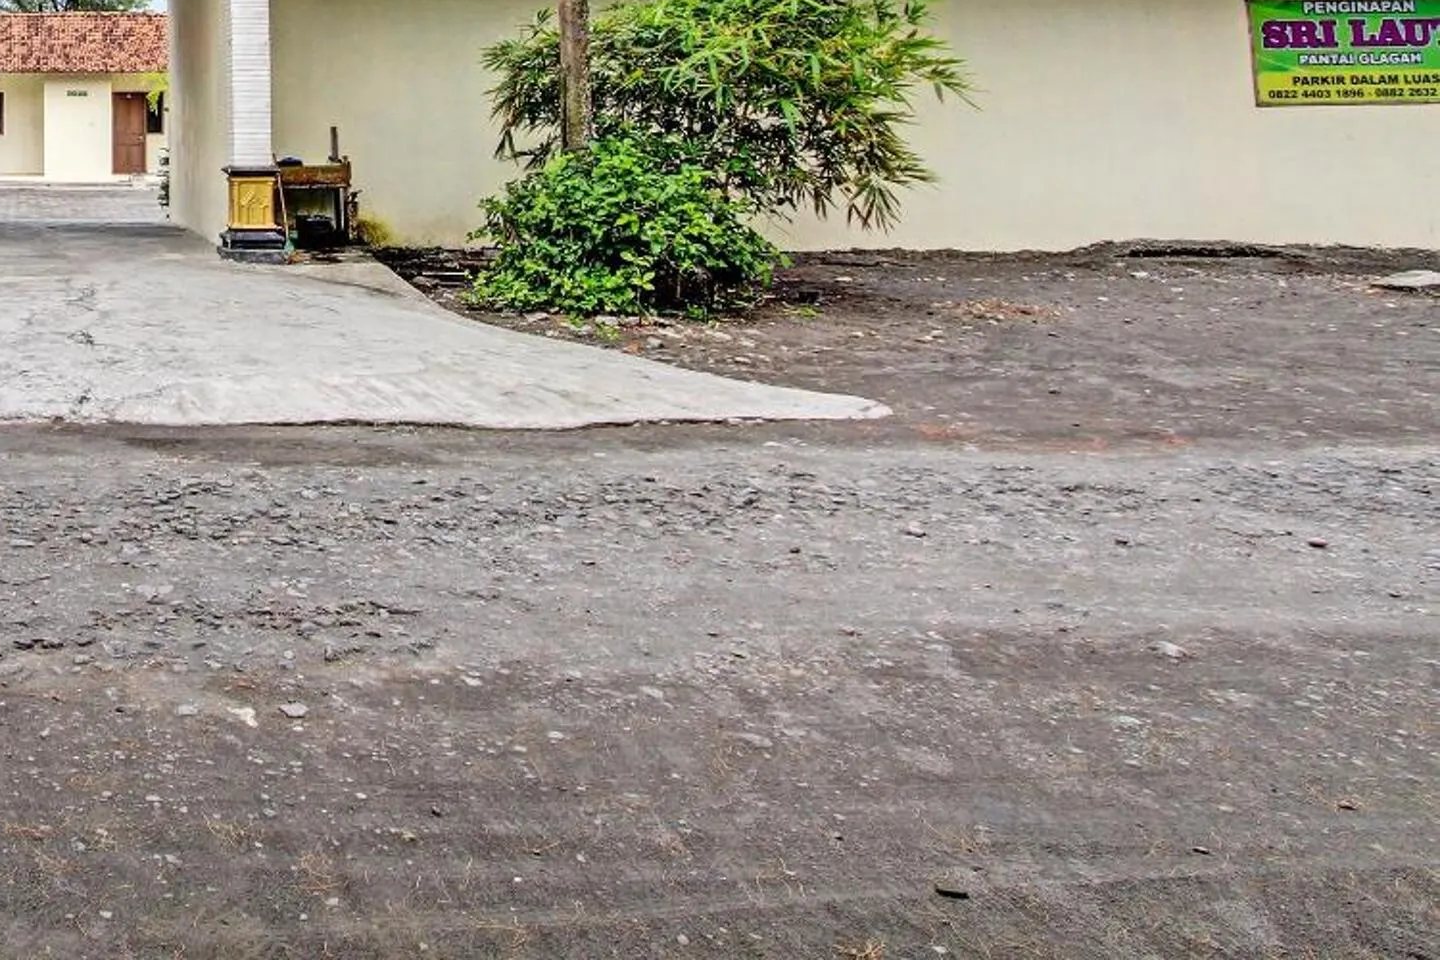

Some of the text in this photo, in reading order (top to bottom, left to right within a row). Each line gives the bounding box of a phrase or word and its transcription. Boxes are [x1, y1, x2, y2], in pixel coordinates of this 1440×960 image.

[1303, 1, 1415, 13] PENGINAPAN
[1261, 21, 1338, 48] SRI
[1299, 53, 1422, 65] PANTAI GLAGAH
[1293, 74, 1440, 86] PARKIR DALAM LUAS
[1269, 90, 1298, 98] 0822
[1302, 89, 1331, 98] 4403
[1409, 88, 1437, 97] 2632
